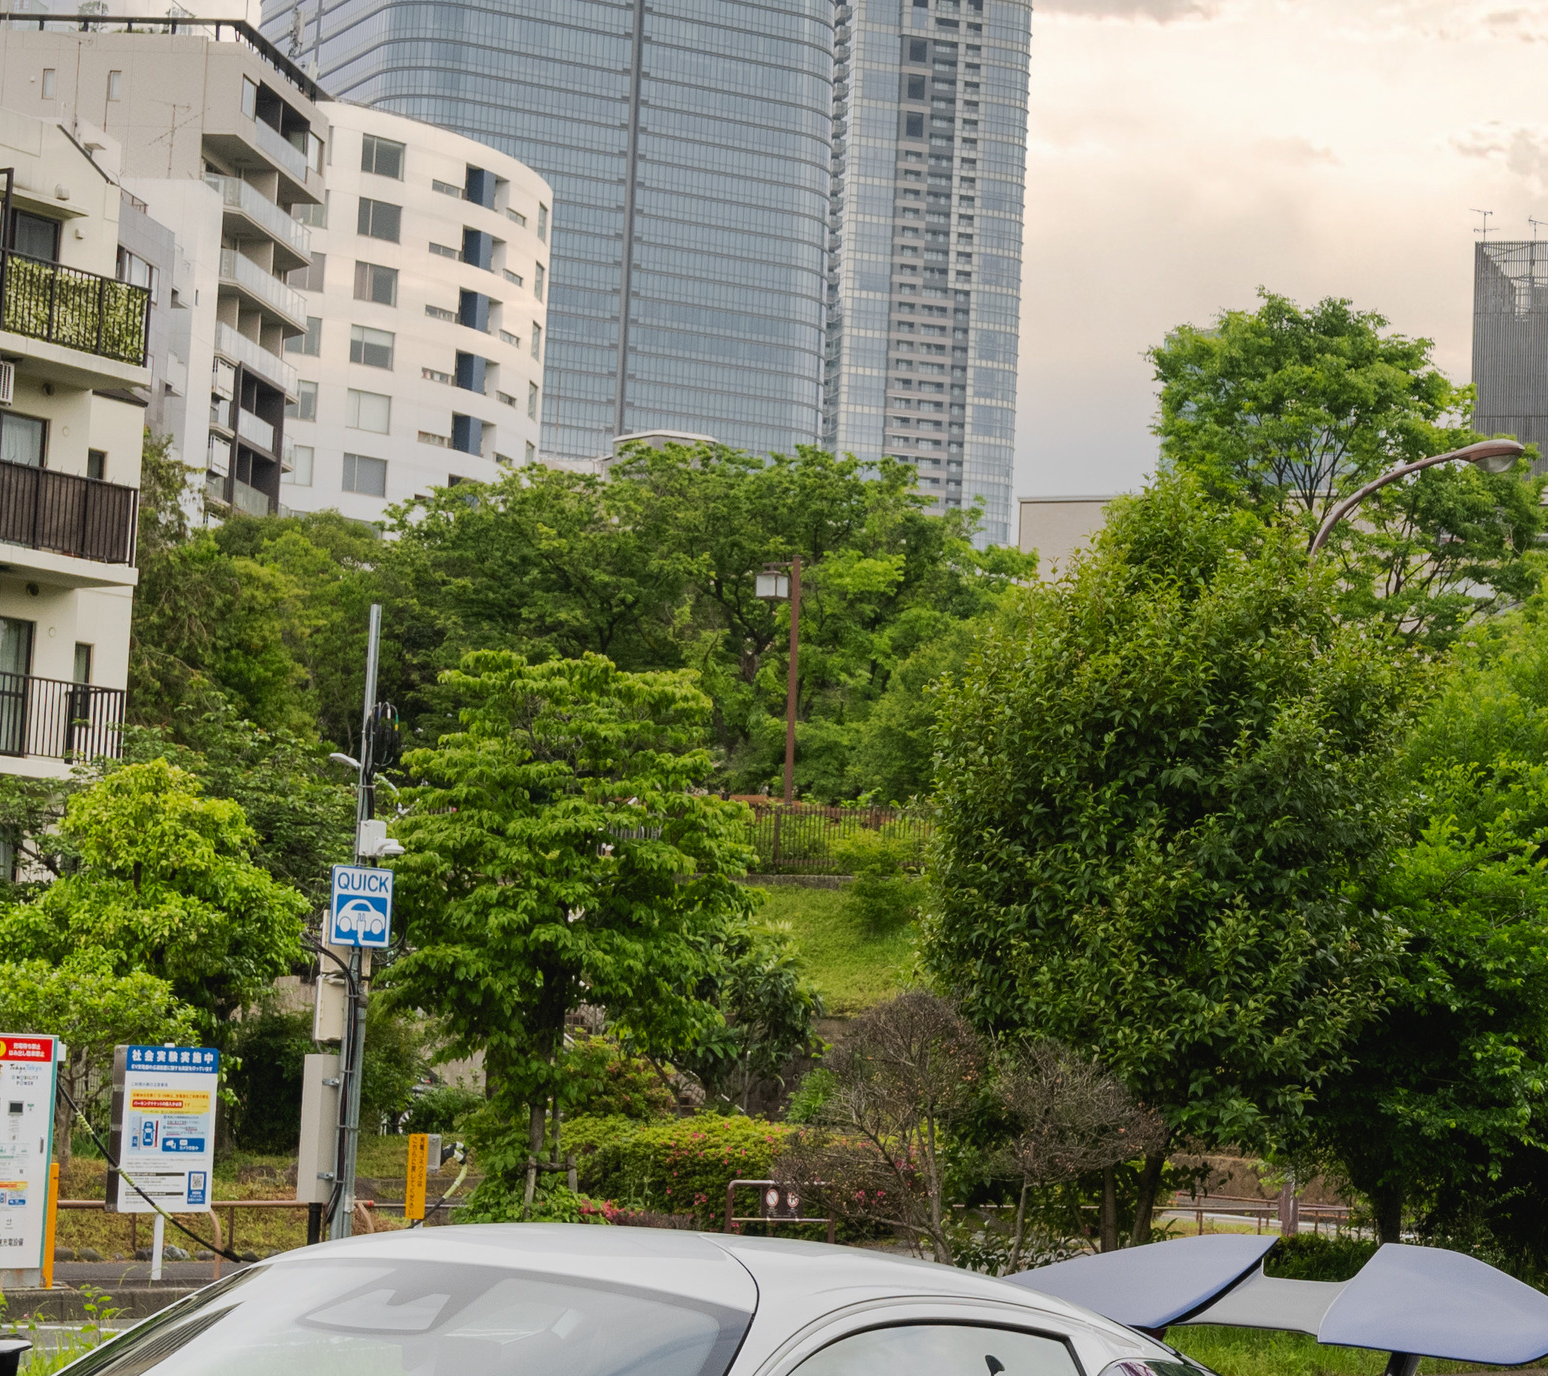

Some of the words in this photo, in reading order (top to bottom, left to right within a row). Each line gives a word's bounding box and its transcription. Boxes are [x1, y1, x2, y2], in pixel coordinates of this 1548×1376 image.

[338, 872, 389, 893] QUICK
[132, 1049, 214, 1064] 社会実験実施中
